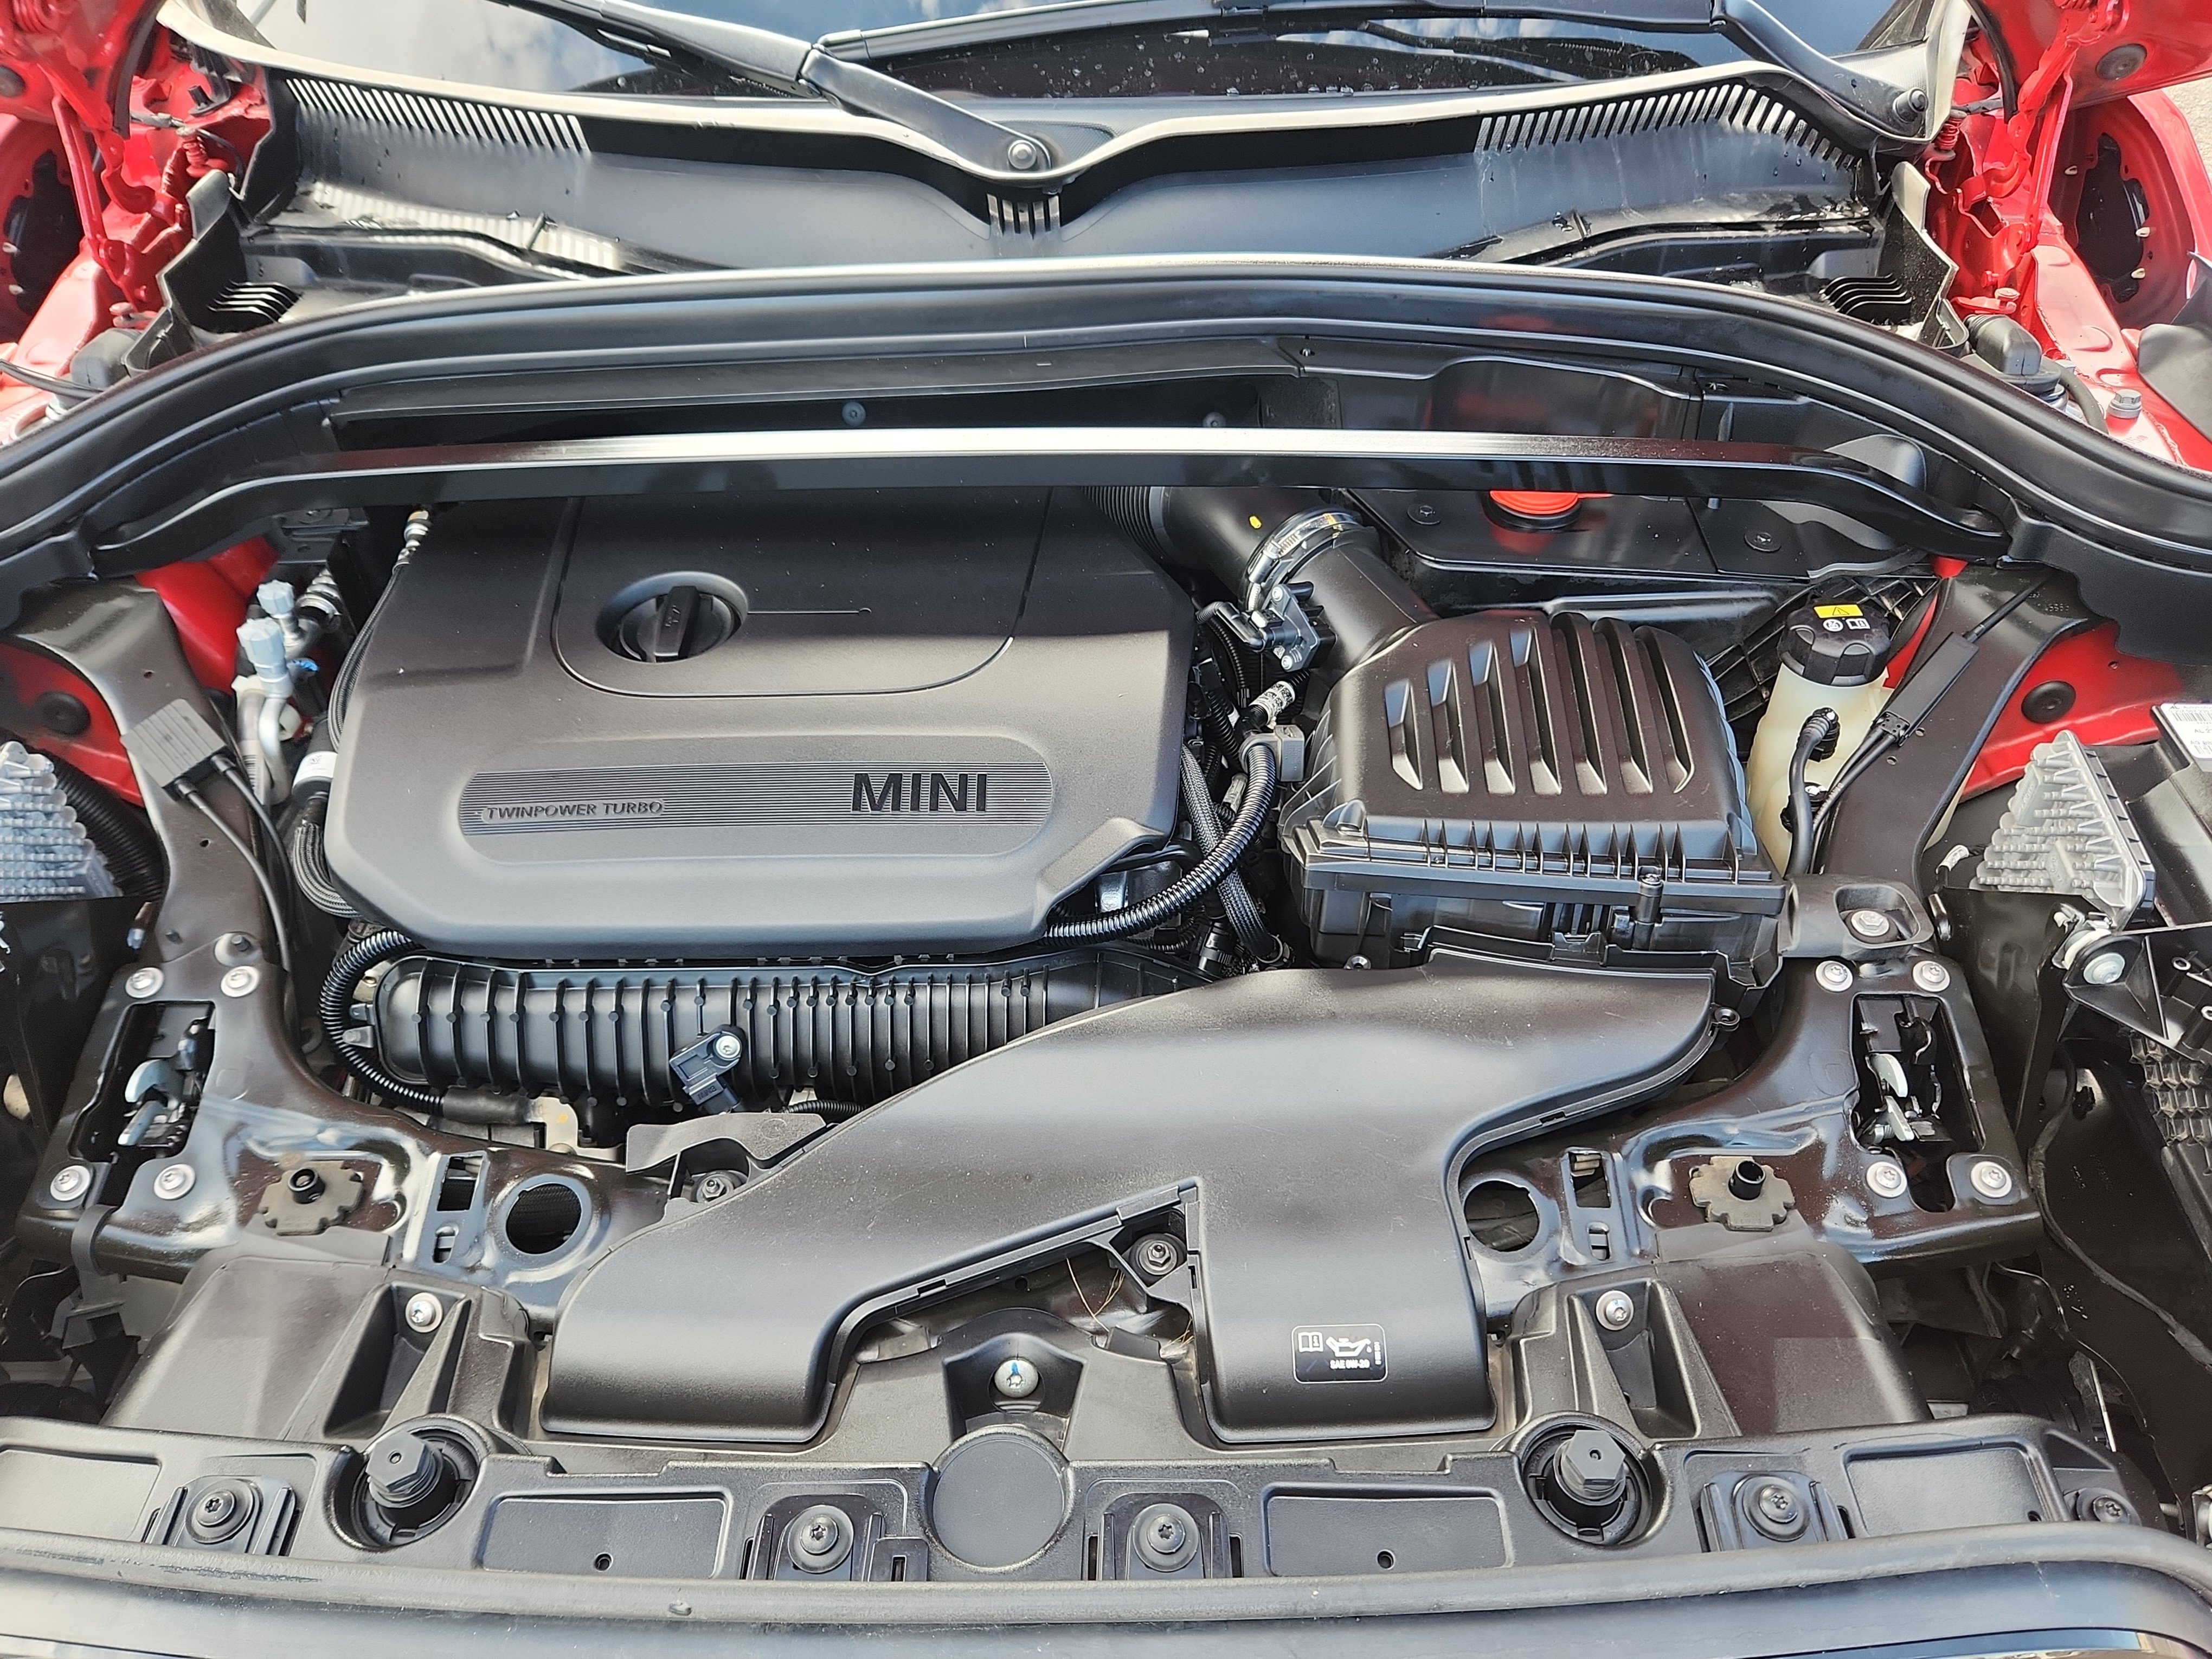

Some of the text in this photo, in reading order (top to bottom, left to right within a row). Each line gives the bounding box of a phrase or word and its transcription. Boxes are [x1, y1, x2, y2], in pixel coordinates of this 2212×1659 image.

[852, 773, 987, 812] MINI
[487, 801, 663, 819] TWINPOWER TURBO
[1330, 1360, 1345, 1369] SAE
